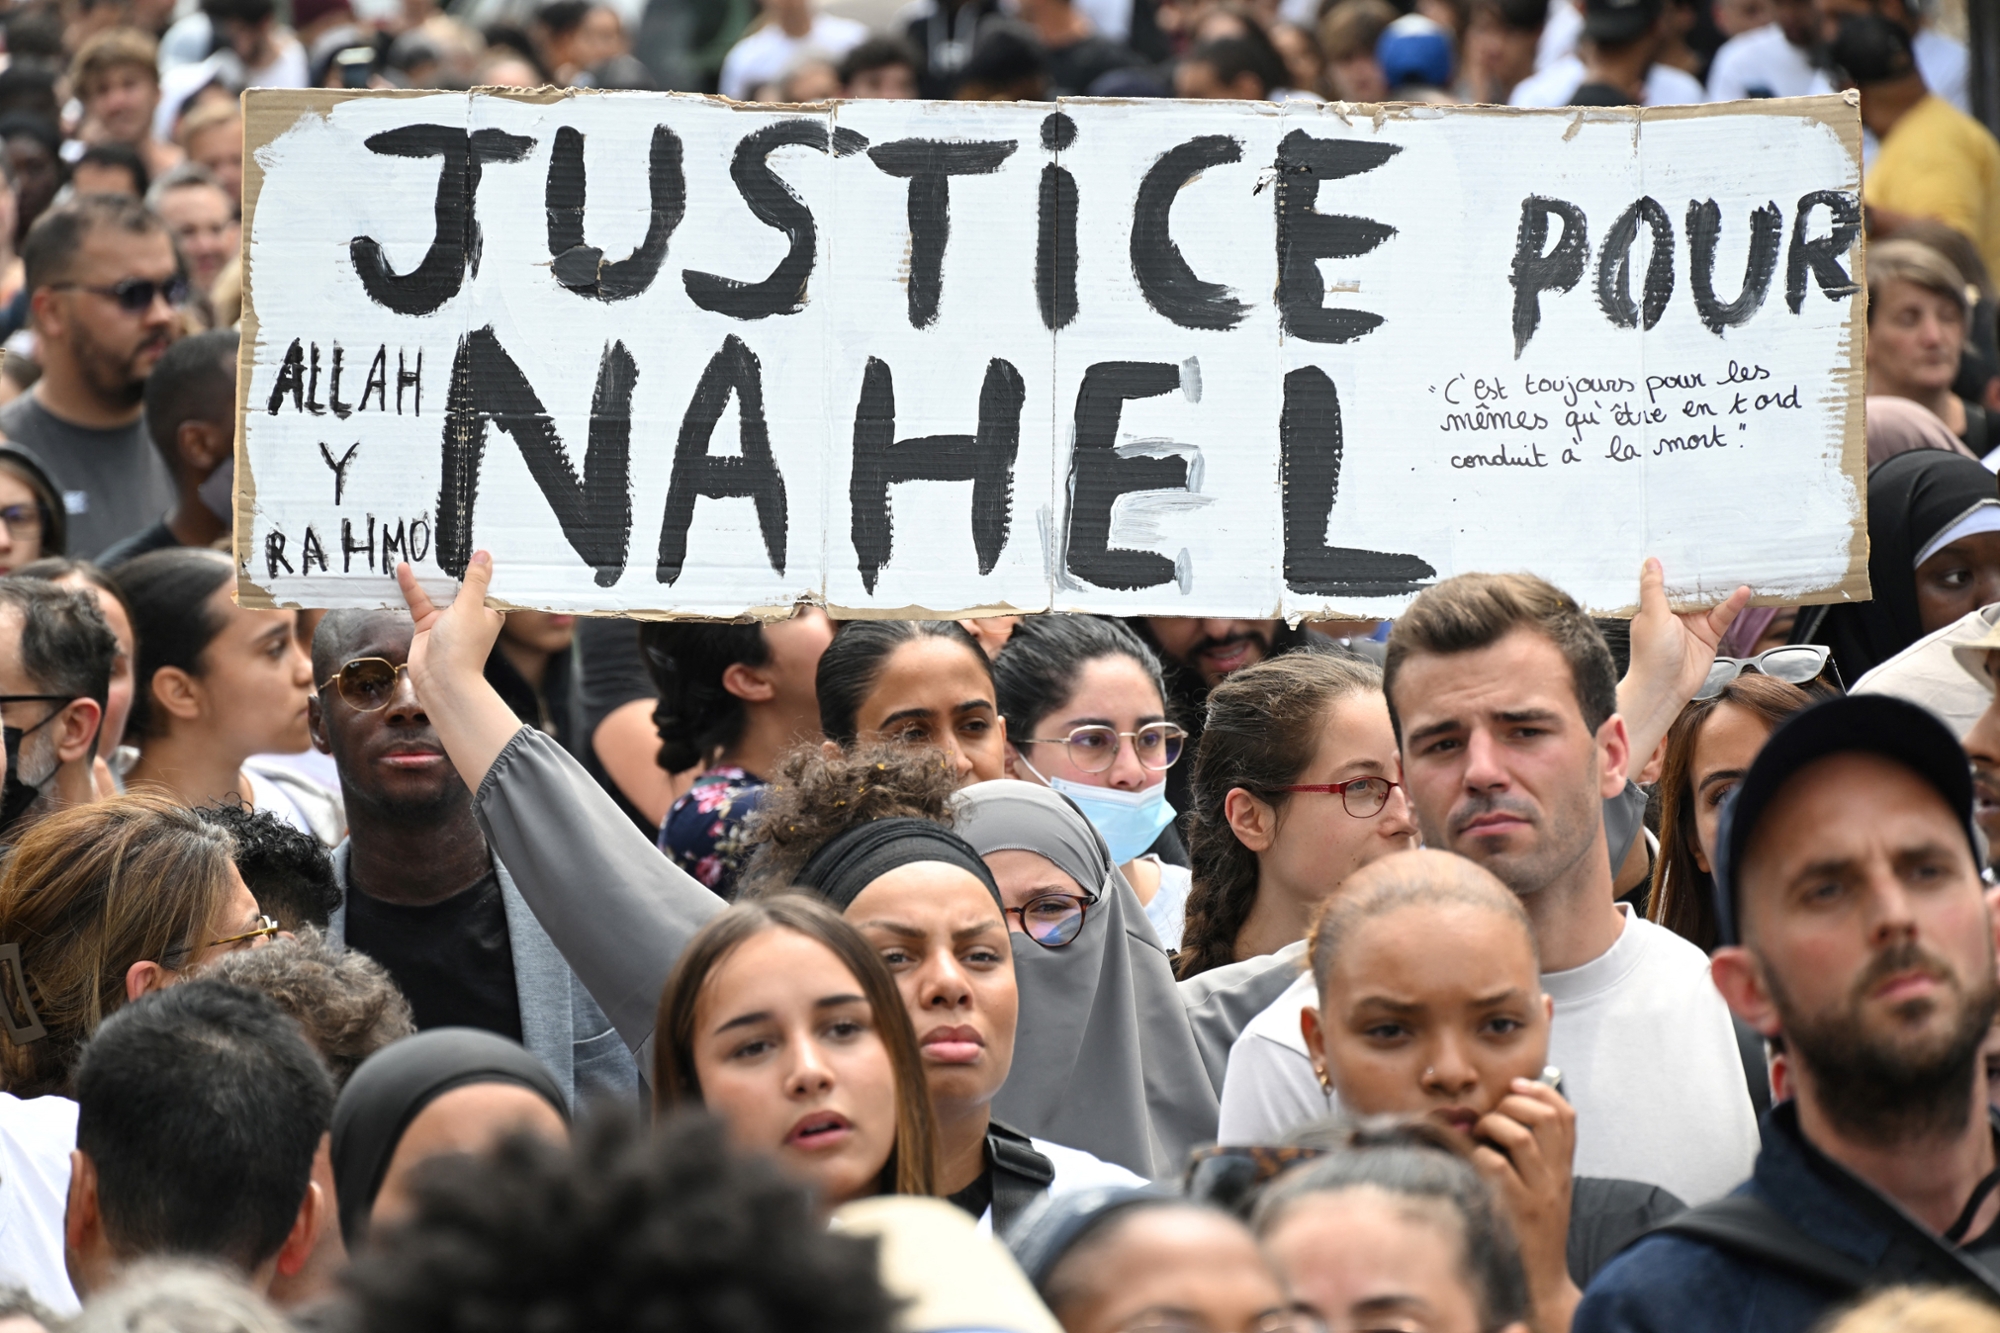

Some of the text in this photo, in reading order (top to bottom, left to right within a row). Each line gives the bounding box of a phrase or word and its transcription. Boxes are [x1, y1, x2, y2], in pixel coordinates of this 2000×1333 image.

[1508, 189, 1861, 361] POUR
[267, 336, 424, 420] ALLAH
[1525, 373, 1636, 408] toujours
[1645, 373, 1707, 404] pour
[1716, 359, 1771, 385] les
[1439, 402, 1549, 432] mêmes
[1681, 399, 1719, 418] en
[318, 440, 361, 507] Y
[434, 321, 1438, 599] NAHEL
[1450, 442, 1549, 469] conduit
[1561, 436, 1583, 465] à
[1604, 434, 1642, 463] la
